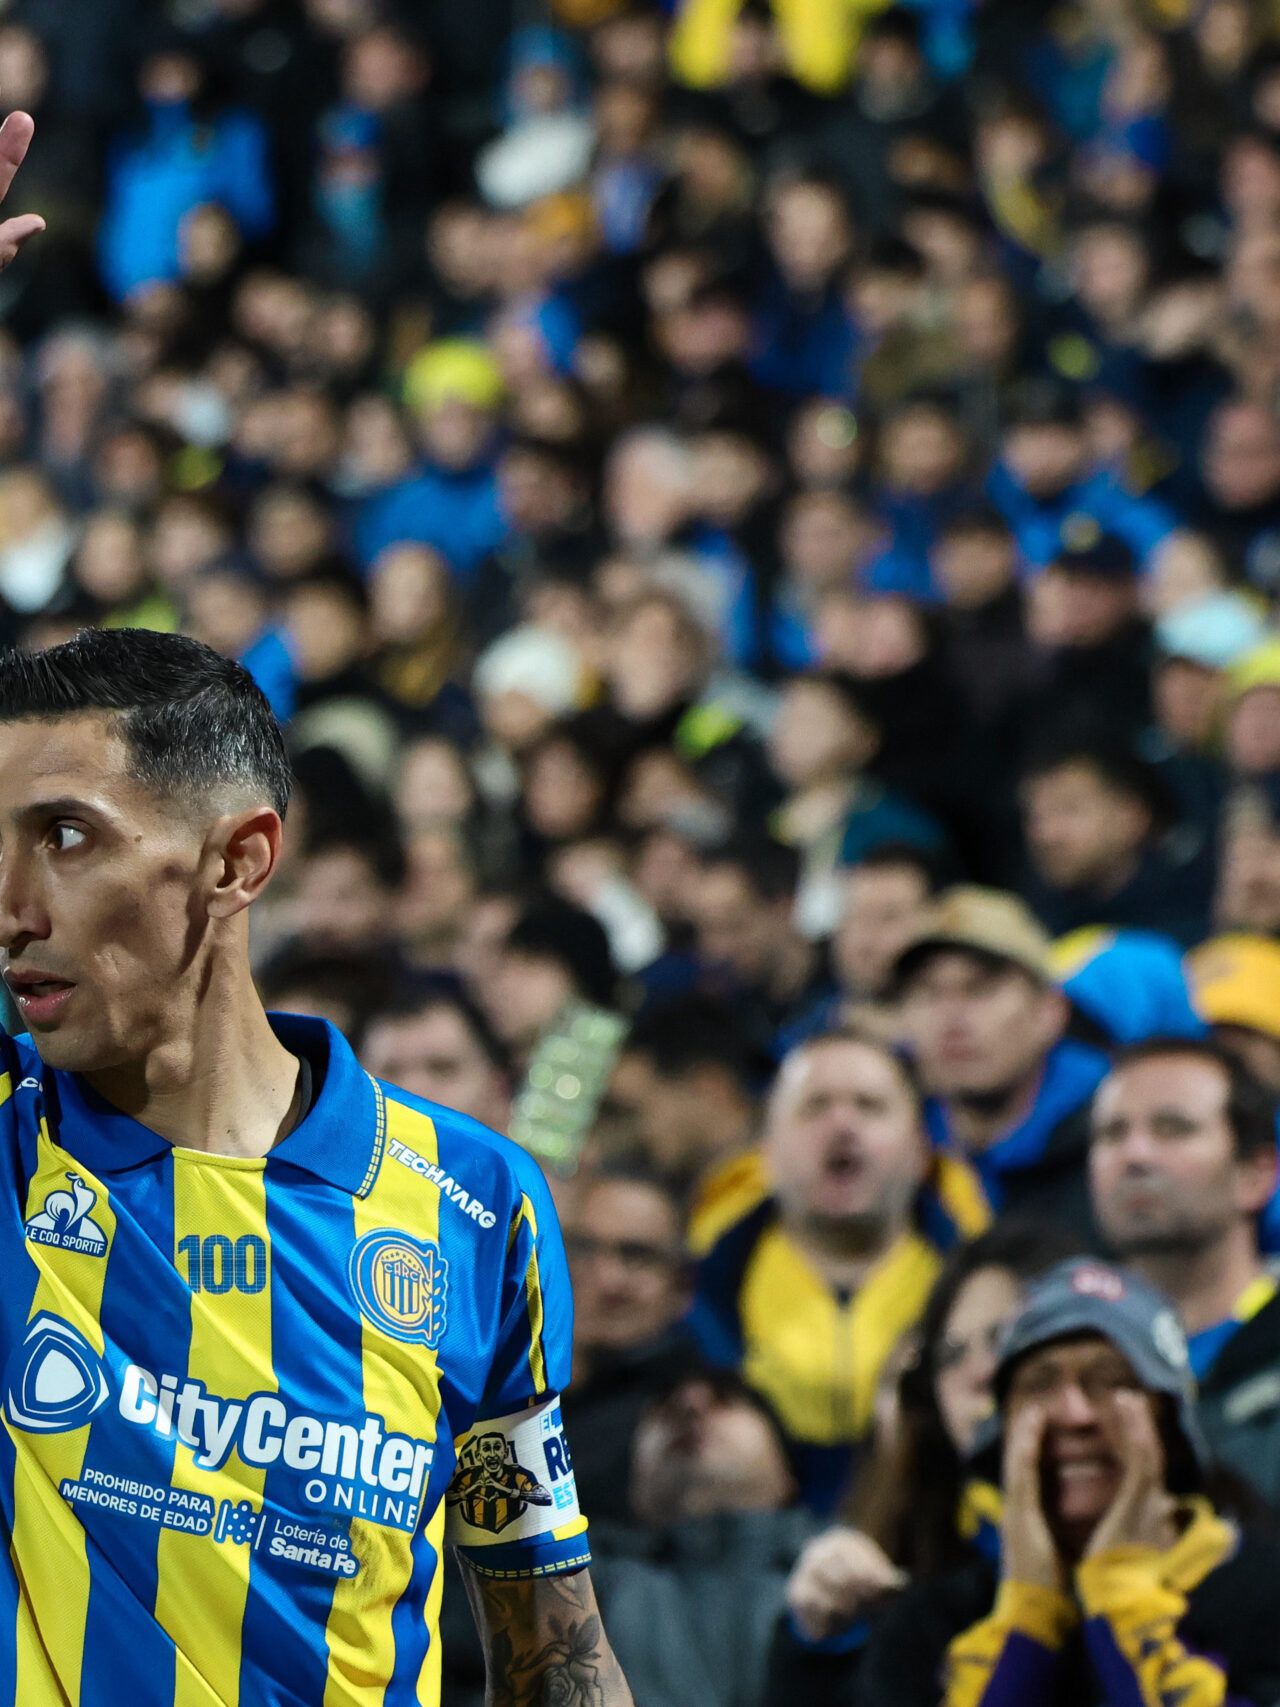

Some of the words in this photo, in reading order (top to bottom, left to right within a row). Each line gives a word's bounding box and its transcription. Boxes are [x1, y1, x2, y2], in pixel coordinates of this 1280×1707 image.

[39, 1230, 60, 1245] COQ
[62, 1235, 105, 1255] SPORTIF
[178, 1234, 266, 1295] 100
[62, 1482, 138, 1515] MENORES
[140, 1504, 162, 1522] DE
[163, 1510, 208, 1532] EDAD
[84, 1468, 166, 1503] PROHIBIDO
[168, 1491, 211, 1514] PARA
[304, 1479, 417, 1528] ONLINE
[269, 1536, 333, 1569] Santa
[332, 1552, 356, 1575] Fe
[274, 1518, 326, 1546] Lotería
[329, 1534, 348, 1551] de
